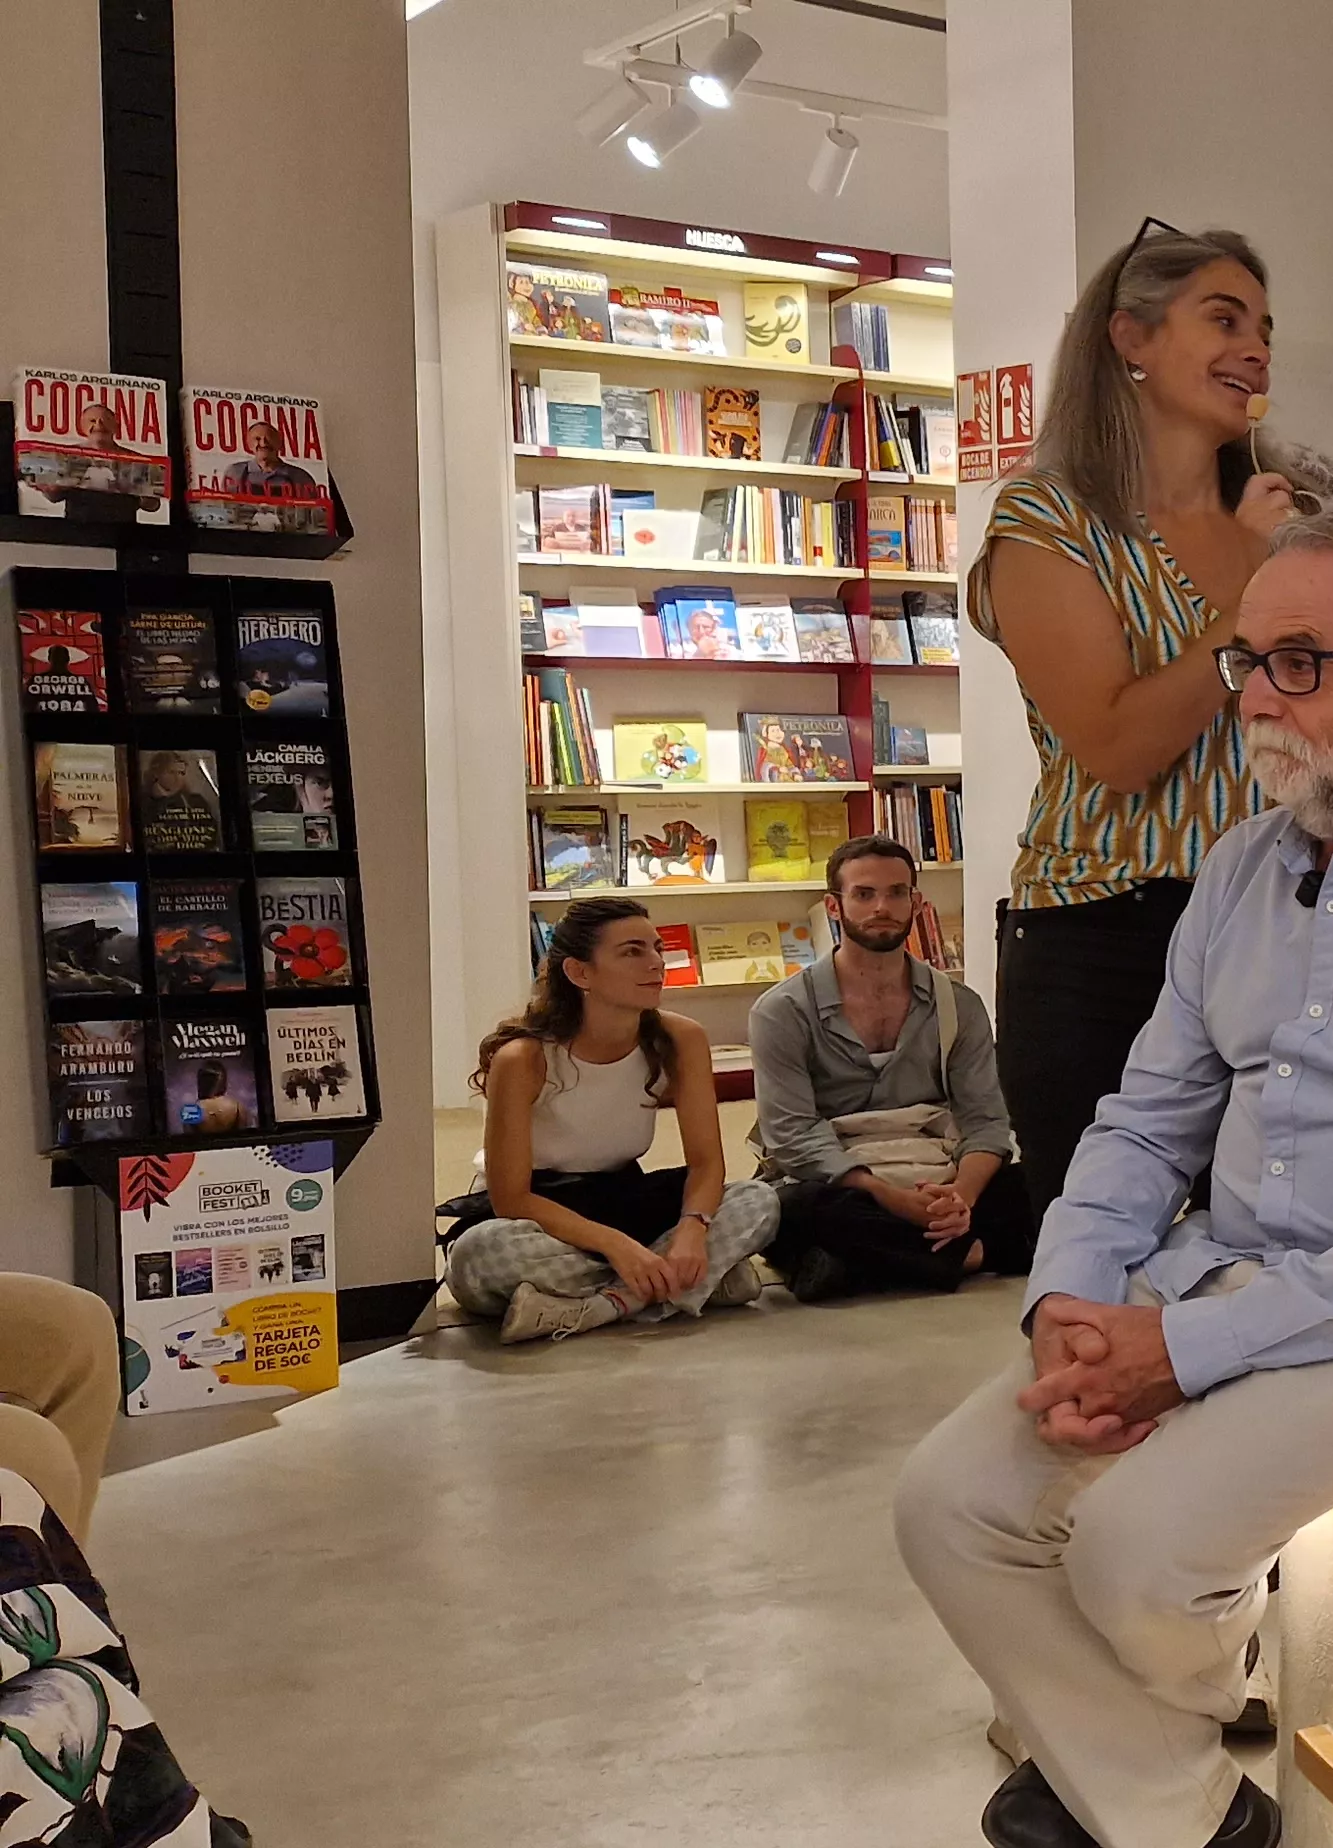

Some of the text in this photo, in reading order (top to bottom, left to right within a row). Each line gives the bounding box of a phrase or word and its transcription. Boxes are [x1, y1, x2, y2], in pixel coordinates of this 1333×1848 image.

[686, 229, 746, 253] HUESCA
[532, 271, 606, 291] PETRONILA
[639, 292, 682, 307] RAMIRO
[25, 369, 160, 391] KARLOS ARGUIÑANO
[192, 388, 319, 409] KARLOS ARGUIÑANO
[961, 453, 980, 466] BOCA
[980, 451, 989, 463] DE
[238, 620, 321, 650] HEREDERO
[34, 675, 85, 684] GEORGE
[28, 684, 93, 695] ORWELL
[782, 720, 845, 731] PETRONILA
[278, 744, 323, 753] CAMILLA
[246, 749, 326, 765] LÄCKBERG
[52, 771, 116, 783] PALMERAS
[248, 773, 303, 785] FEXEUS
[277, 1025, 337, 1039] ÚLTIMOS
[61, 1041, 133, 1056] FERNANDO
[293, 1038, 346, 1050] DÍAS EN
[286, 1049, 336, 1063] BERLÍN
[60, 1060, 134, 1077] ARAMBURU
[86, 1089, 112, 1103] LOS
[66, 1104, 133, 1121] VENCEJOS
[202, 1183, 259, 1197] BOOKET
[203, 1198, 236, 1210] FEST
[173, 1213, 289, 1231] VIBRA CON LOS MEJORES
[172, 1223, 290, 1242] BESTSELLERS EN BOLSILLO
[253, 1325, 321, 1343] TARJETA
[254, 1353, 312, 1372] DE 50€
